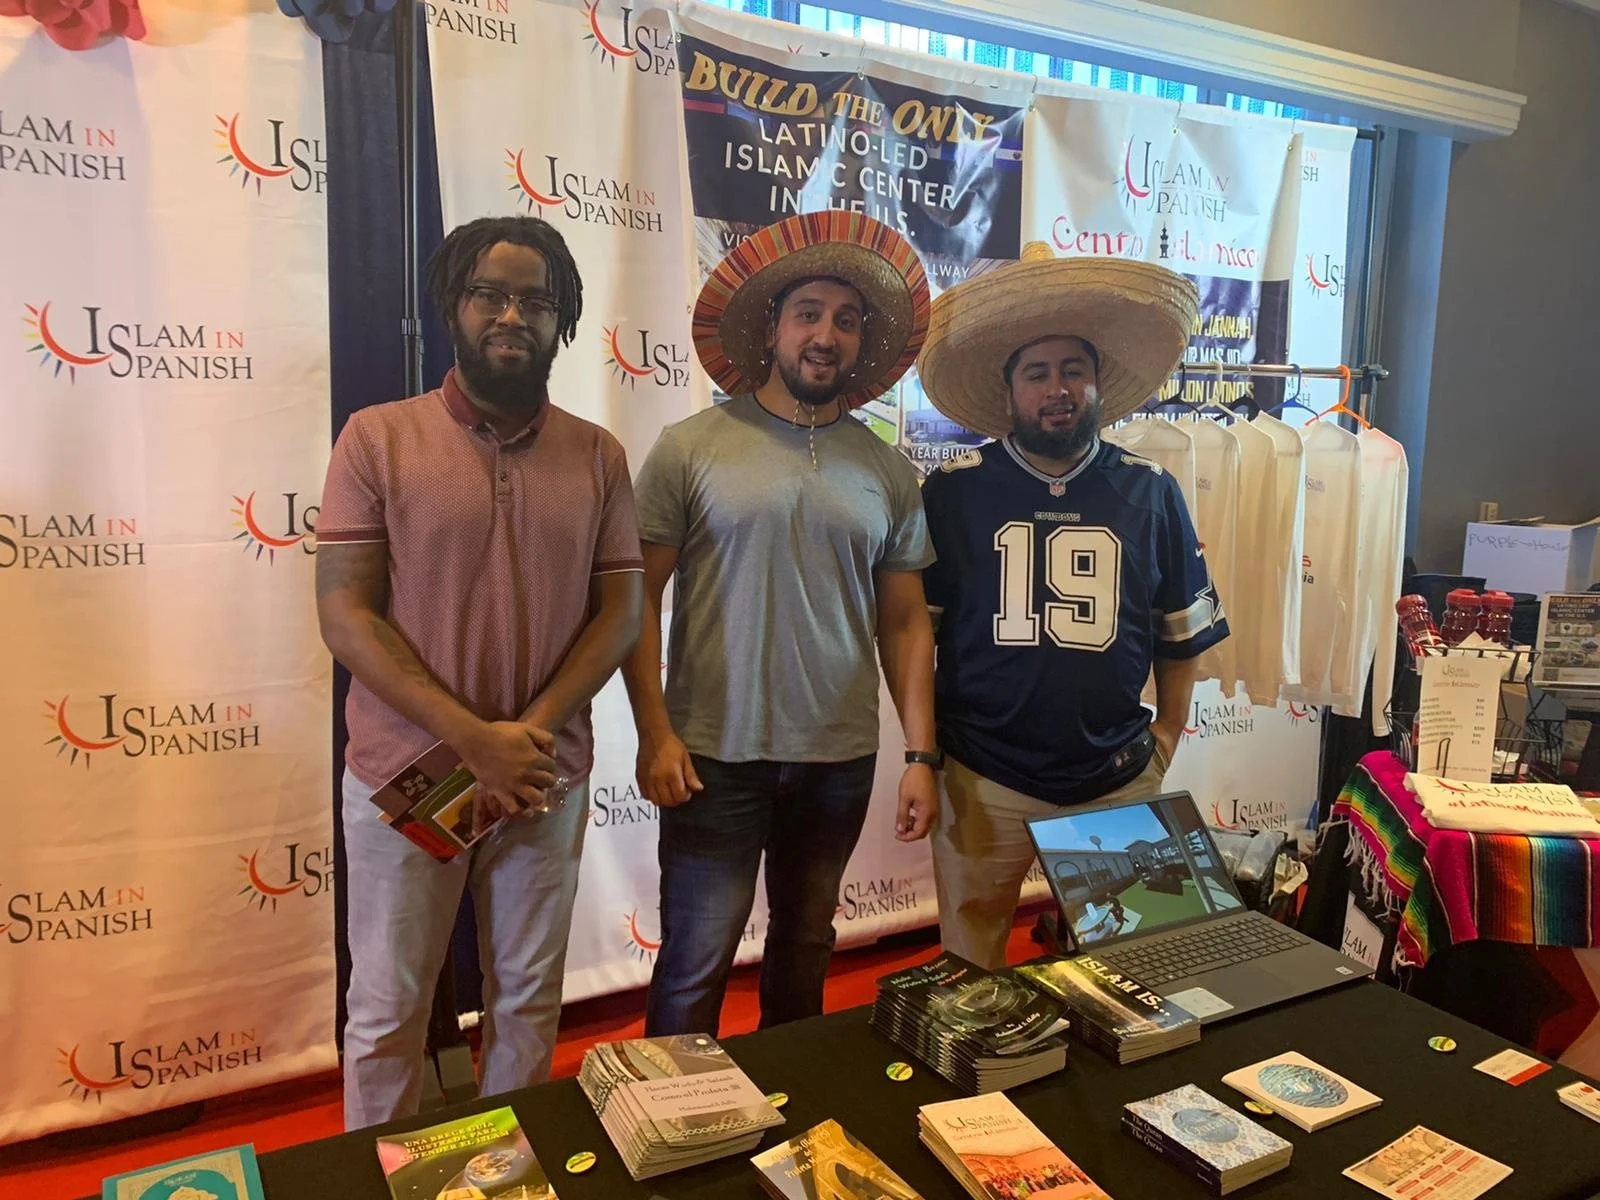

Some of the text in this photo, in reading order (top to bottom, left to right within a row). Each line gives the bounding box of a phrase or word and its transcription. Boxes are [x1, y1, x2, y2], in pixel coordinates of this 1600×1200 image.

[685, 51, 995, 144] BUILD THE ONLY
[85, 127, 116, 147] IN
[758, 118, 929, 171] LATINO-LED
[545, 155, 656, 207] ISLAM IN
[724, 142, 955, 210] ISLAMC CENTER
[1143, 140, 1203, 188] ISLAM
[563, 174, 663, 233] SPANISH
[82, 306, 244, 356] ISLAM IN
[1205, 315, 1252, 339] JANNAH
[108, 324, 253, 380] SPANISH
[910, 448, 939, 460] YEAR
[106, 518, 137, 536] IN
[1034, 511, 1081, 522] COWBOYS
[992, 520, 1122, 652] 19
[99, 694, 253, 740] ISLAM IN
[122, 706, 260, 757] SPANISH
[1194, 701, 1235, 728] ISLAM
[1200, 708, 1254, 739] SPANISH
[1232, 799, 1273, 824] ISLAM
[117, 887, 145, 906] IN
[844, 884, 918, 921] SPANISH
[898, 877, 913, 892] IN
[8, 894, 153, 944] SPANISH
[1077, 956, 1136, 994] ISLAM
[108, 1028, 257, 1080] ISLAM IN
[131, 1046, 262, 1090] SPANISH
